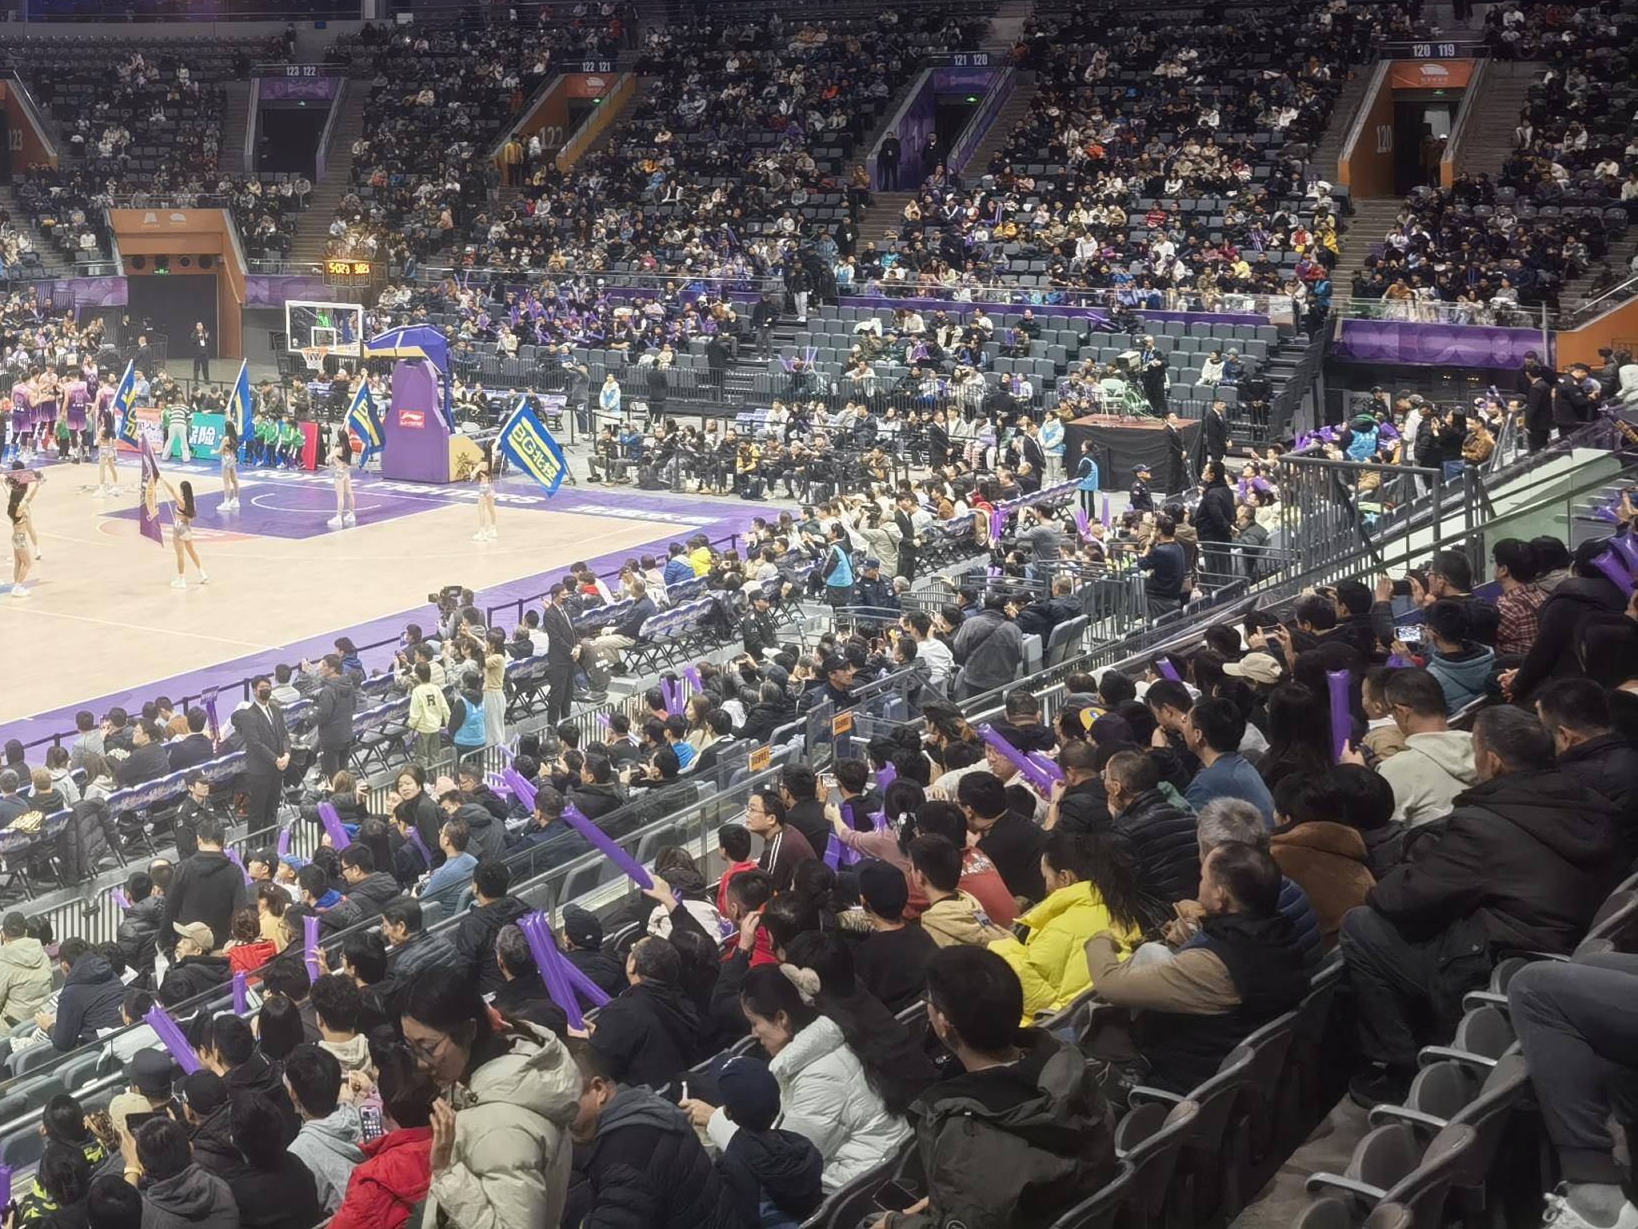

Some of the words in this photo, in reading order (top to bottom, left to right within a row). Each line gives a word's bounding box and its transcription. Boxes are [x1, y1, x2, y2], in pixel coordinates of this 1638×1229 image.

[1413, 45, 1432, 57] 120
[1437, 43, 1455, 57] 119
[954, 53, 967, 66] 121
[972, 53, 987, 66] 120
[286, 66, 299, 76] 123
[303, 66, 316, 76] 122
[582, 61, 595, 72] 122
[598, 61, 611, 72] 121
[1376, 124, 1393, 154] 120
[511, 425, 559, 482] BG北控
[426, 694, 437, 706] R
